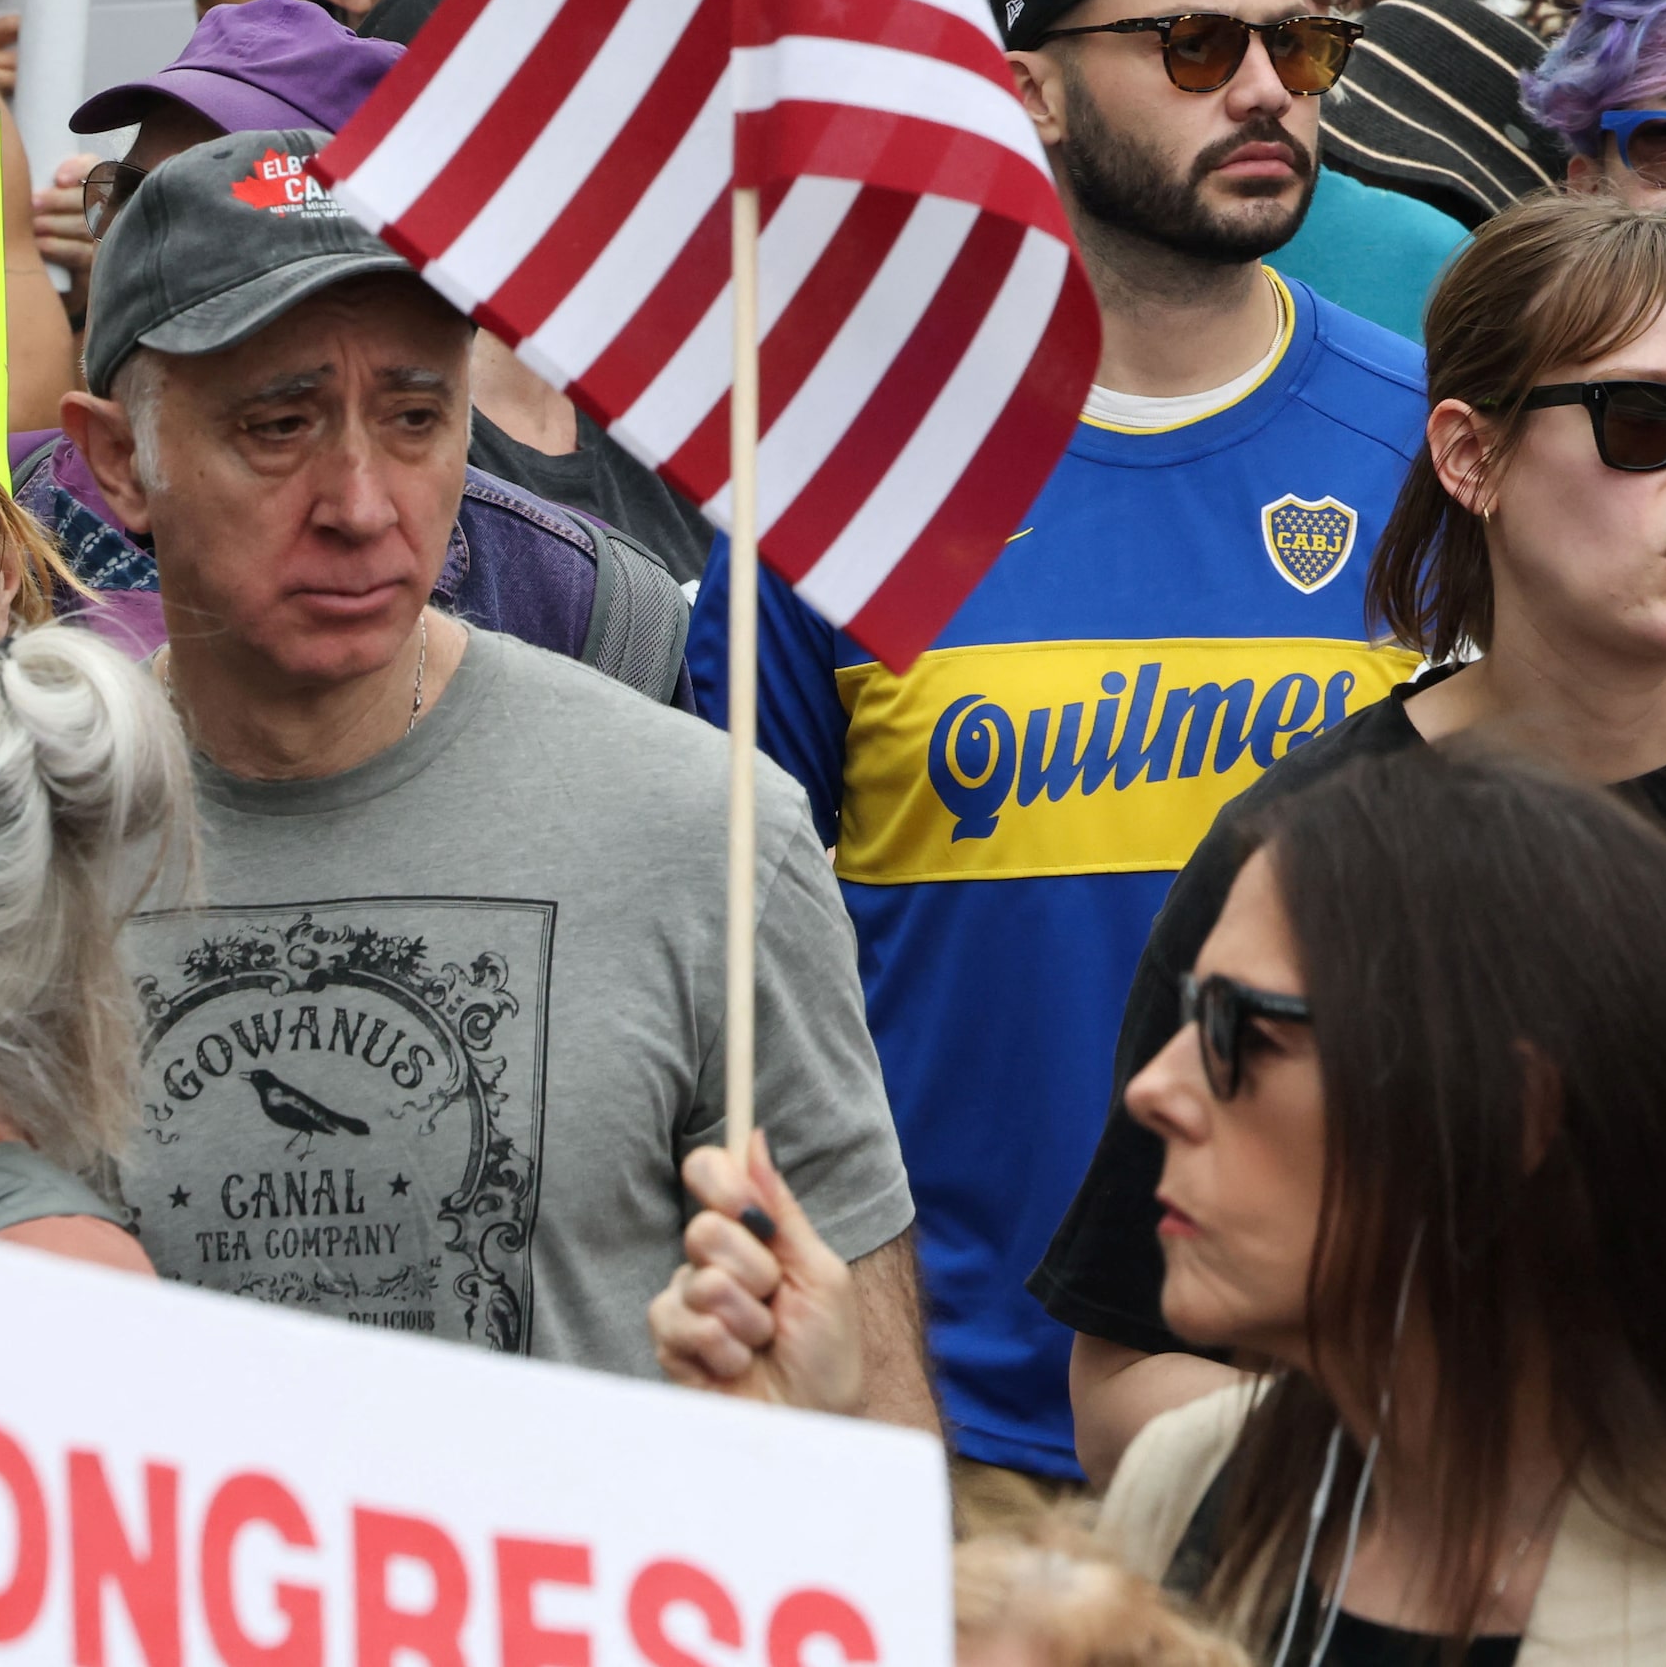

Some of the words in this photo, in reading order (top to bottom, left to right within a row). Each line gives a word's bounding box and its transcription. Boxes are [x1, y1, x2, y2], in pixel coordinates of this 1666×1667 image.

[1276, 531, 1343, 554] CABJ
[928, 661, 1356, 844] Quilmes
[163, 1005, 435, 1103] GOWANUS
[220, 1168, 366, 1221] CANAL
[195, 1230, 253, 1263] TEA
[264, 1224, 401, 1260] COMPANY
[347, 1309, 437, 1332] DELICIOUS
